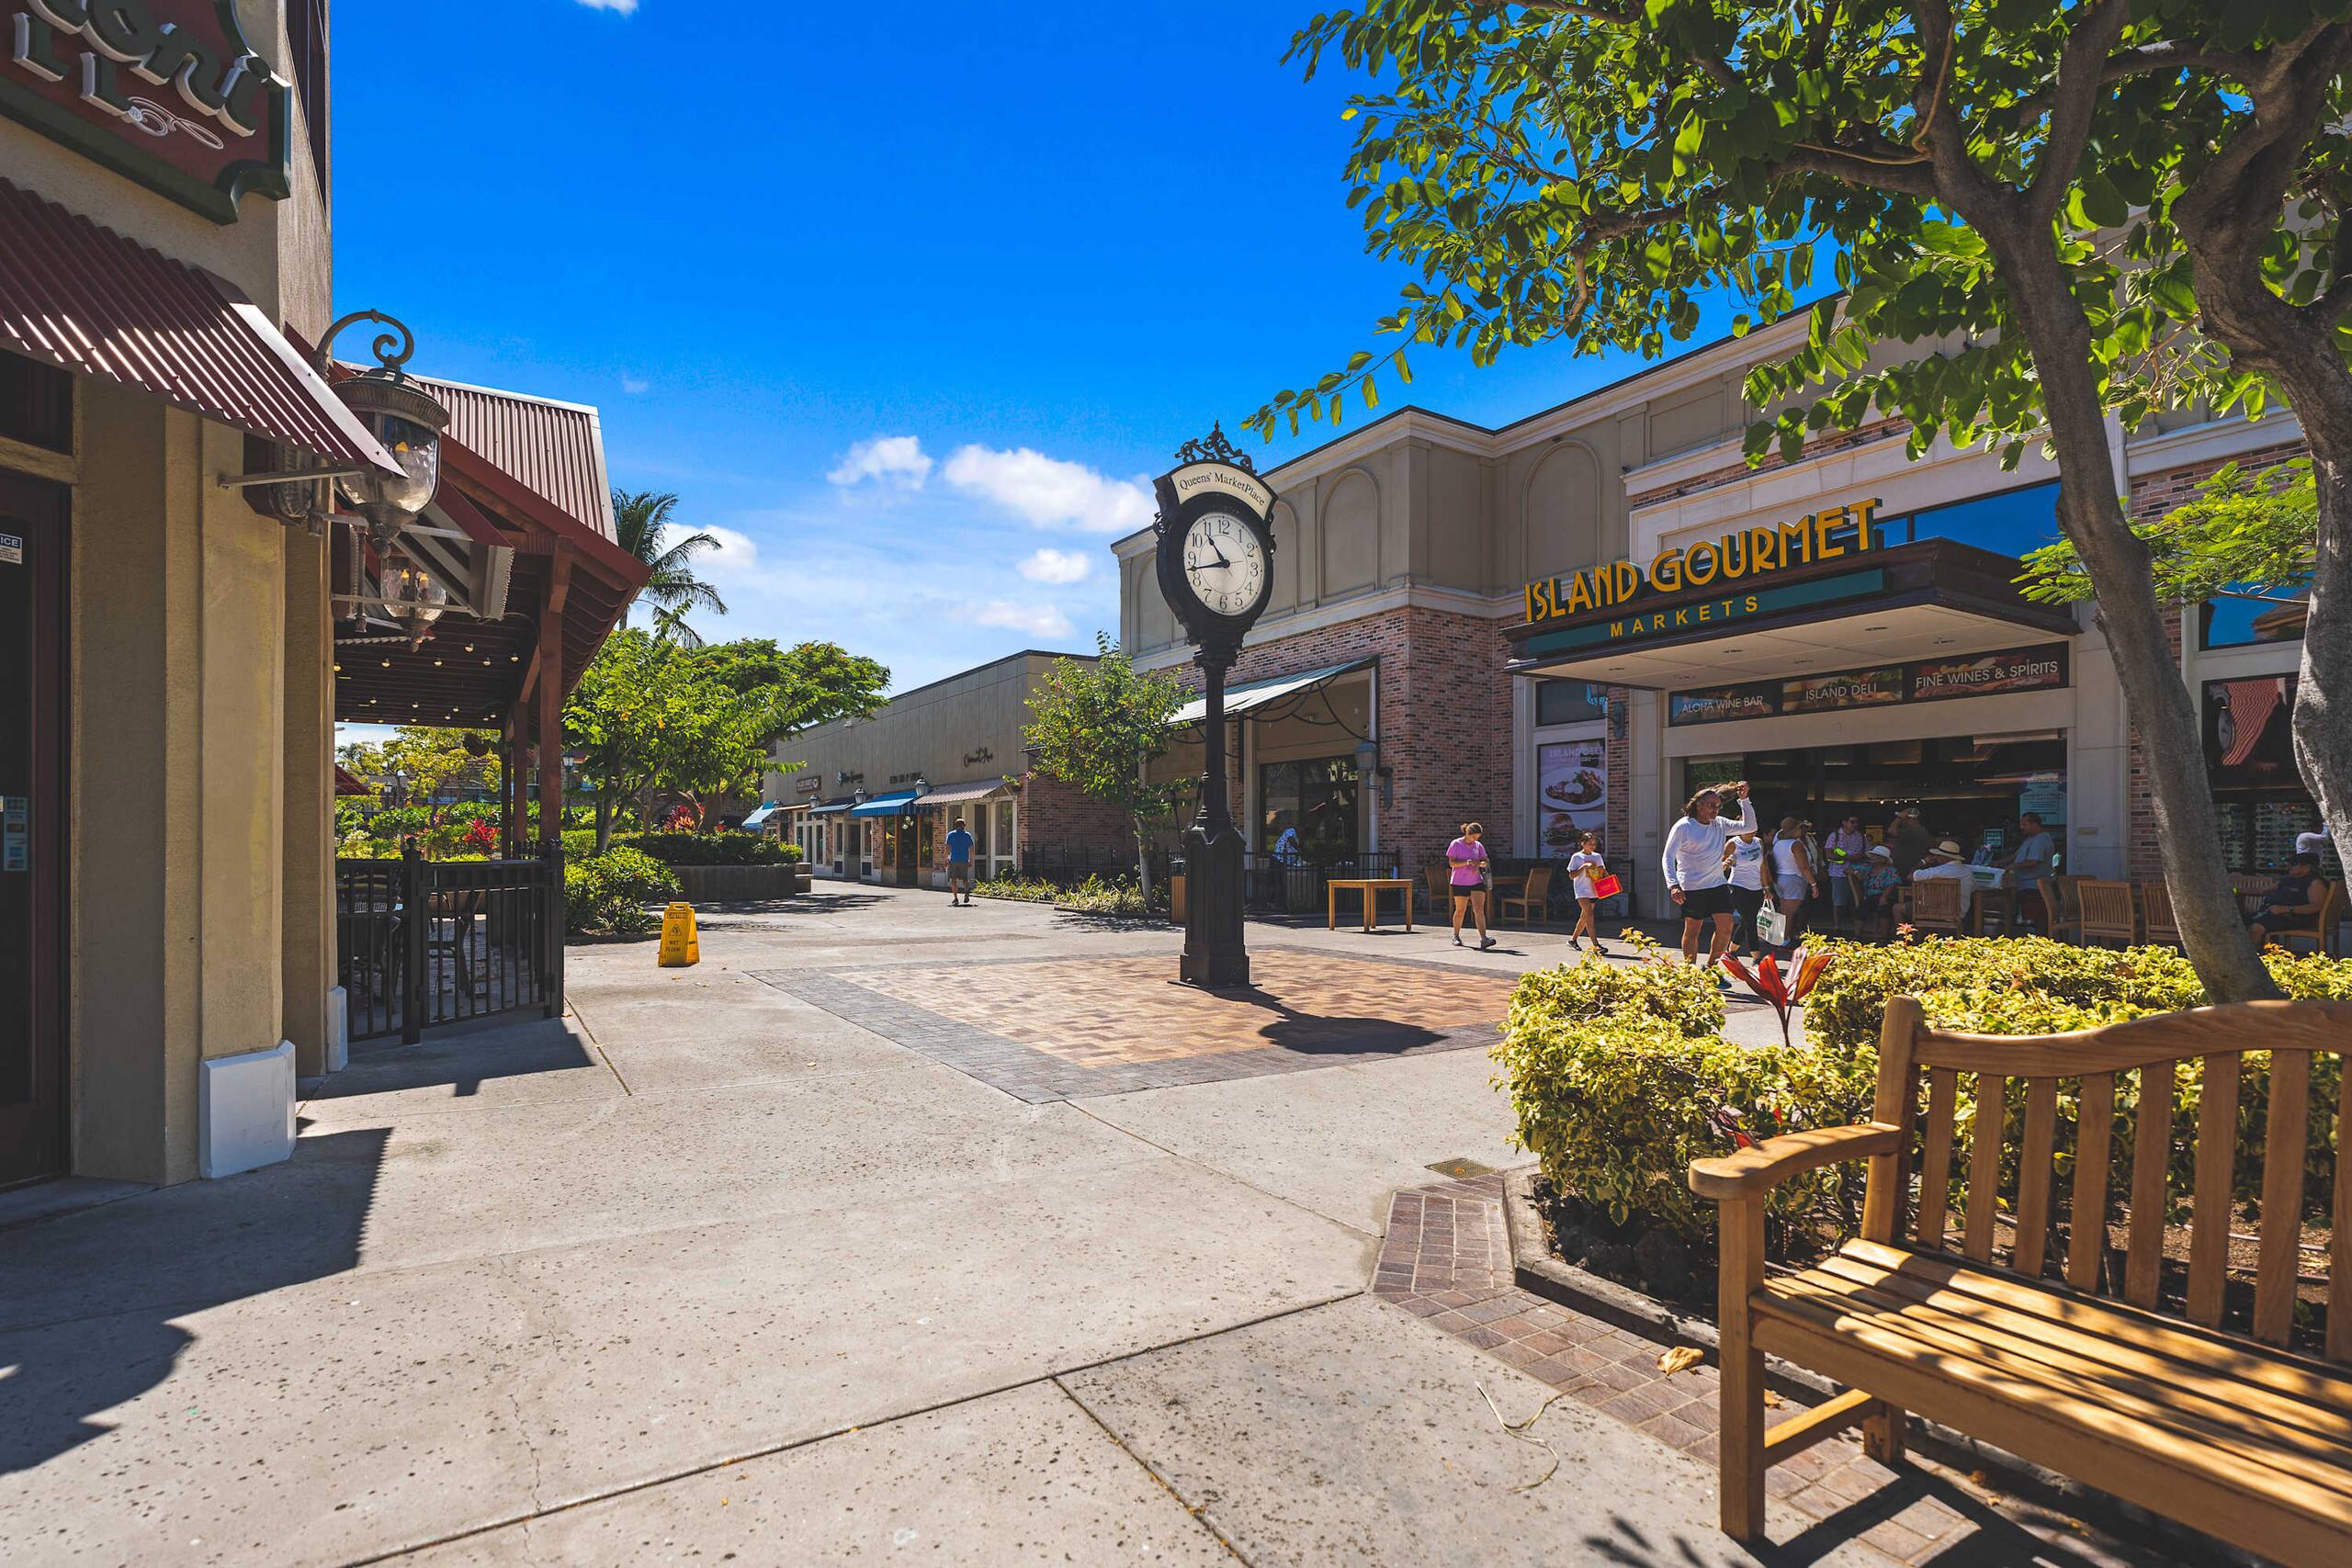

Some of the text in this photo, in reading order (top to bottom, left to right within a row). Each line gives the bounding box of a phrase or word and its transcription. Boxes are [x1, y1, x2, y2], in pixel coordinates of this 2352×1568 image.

[1180, 472, 1265, 506] Queens' MarketPlace
[1217, 519, 1230, 535] 12
[1192, 533, 1203, 548] 10
[1246, 543, 1255, 558] 2
[1188, 551, 1197, 567] 9
[1523, 498, 1883, 623] ISLAND GOURMET
[1250, 562, 1259, 578] 3
[1193, 571, 1202, 587] 8
[1204, 588, 1212, 604] 7
[1244, 581, 1254, 595] 4
[1219, 595, 1228, 610] 6
[1235, 592, 1243, 607] 5
[1610, 595, 1758, 638] MARKETS
[1916, 660, 2059, 689] FINE WINES & SPIRITS
[1805, 682, 1878, 700] ISLAND DELI
[1682, 695, 1764, 715] ALOHA WINE BAR
